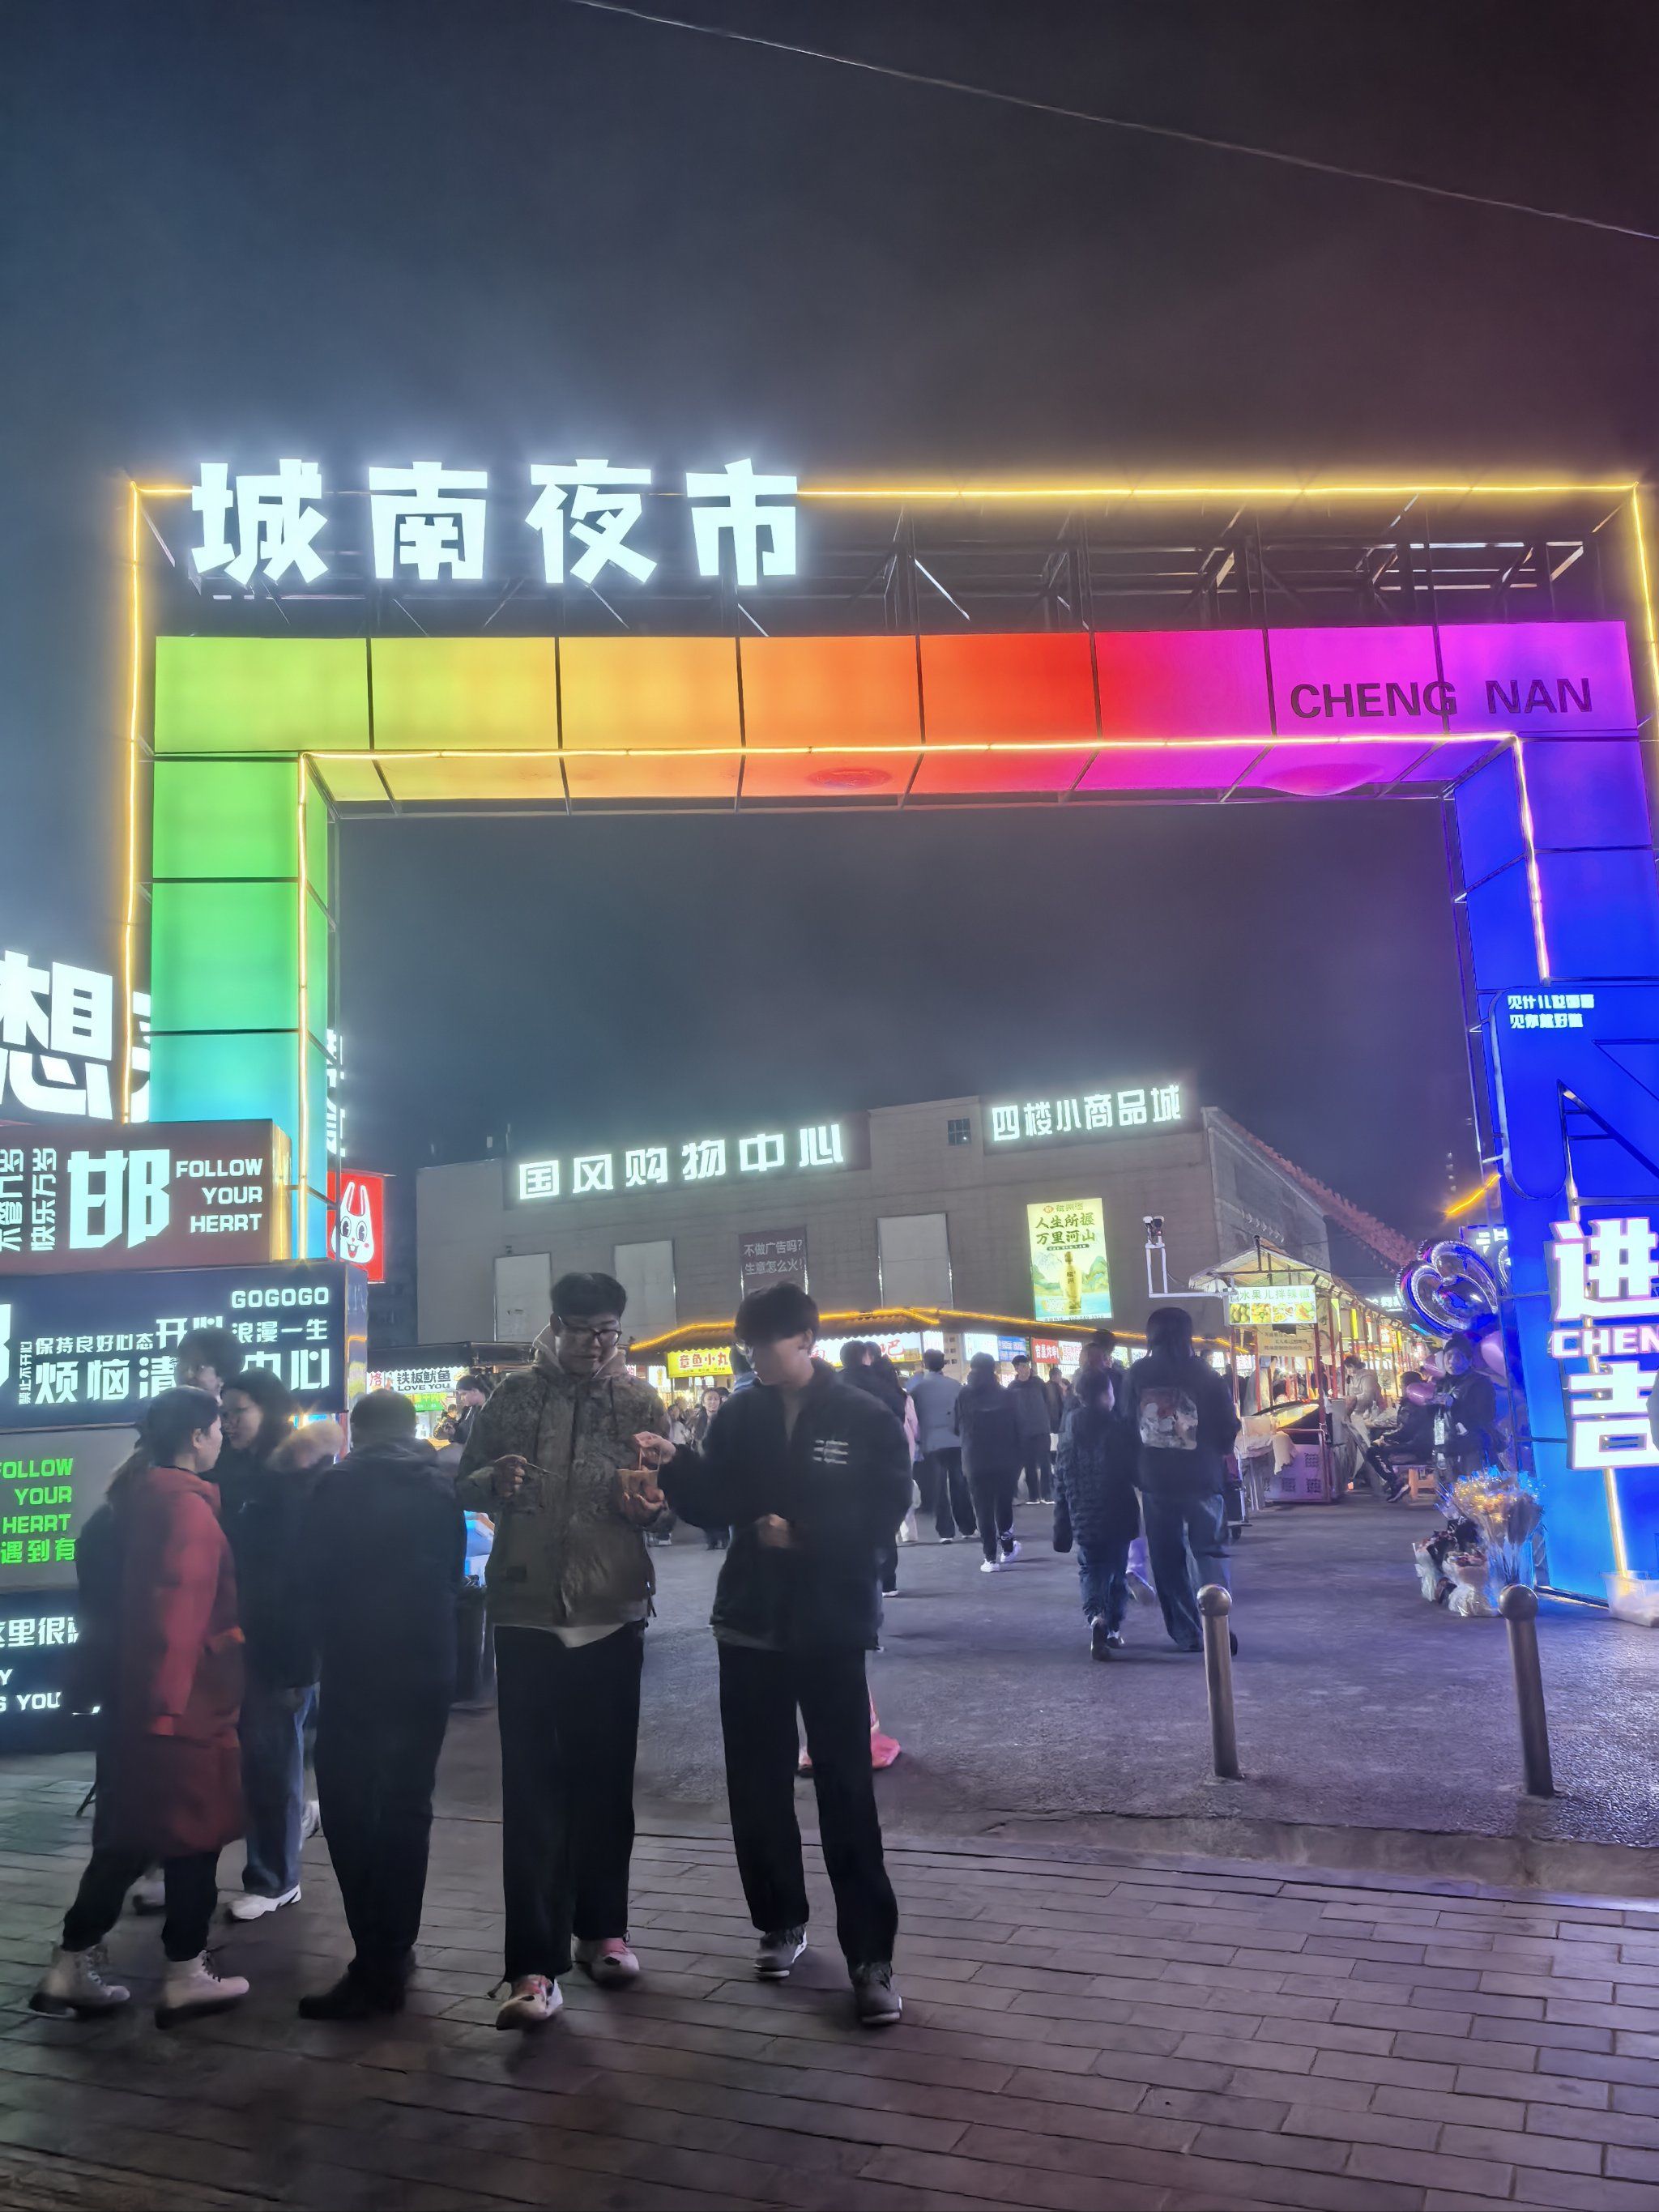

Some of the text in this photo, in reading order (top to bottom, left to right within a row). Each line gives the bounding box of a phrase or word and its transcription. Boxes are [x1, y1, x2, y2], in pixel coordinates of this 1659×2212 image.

[191, 458, 798, 585] 城南夜市
[1291, 678, 1592, 718] CHENG NAN
[0, 950, 151, 1123] 想
[992, 1085, 1181, 1141] 四楼小商品城
[176, 1158, 262, 1178] FOLLOW
[519, 1123, 843, 1199] 国风购物中心
[31, 1149, 57, 1251] 快乐万岁
[68, 1149, 170, 1248] 邯
[202, 1187, 262, 1204] YOUR
[1035, 1213, 1095, 1230] 人生所握
[1036, 1229, 1095, 1245] 万里河山
[232, 1287, 329, 1308] GOGOGO
[232, 1319, 327, 1343] 浪漫一生
[35, 1333, 154, 1355] 保持良好心态
[680, 1353, 728, 1369] 章鱼小丸
[35, 1349, 330, 1404] 烦恼清中心
[397, 1370, 451, 1384] 铁板鱿鱼
[0, 1458, 73, 1479] OLLOW
[15, 1486, 72, 1505] YOUR
[1, 1538, 76, 1564] 遇到有
[0, 1617, 79, 1647] 里很
[17, 1692, 62, 1711] YOU
